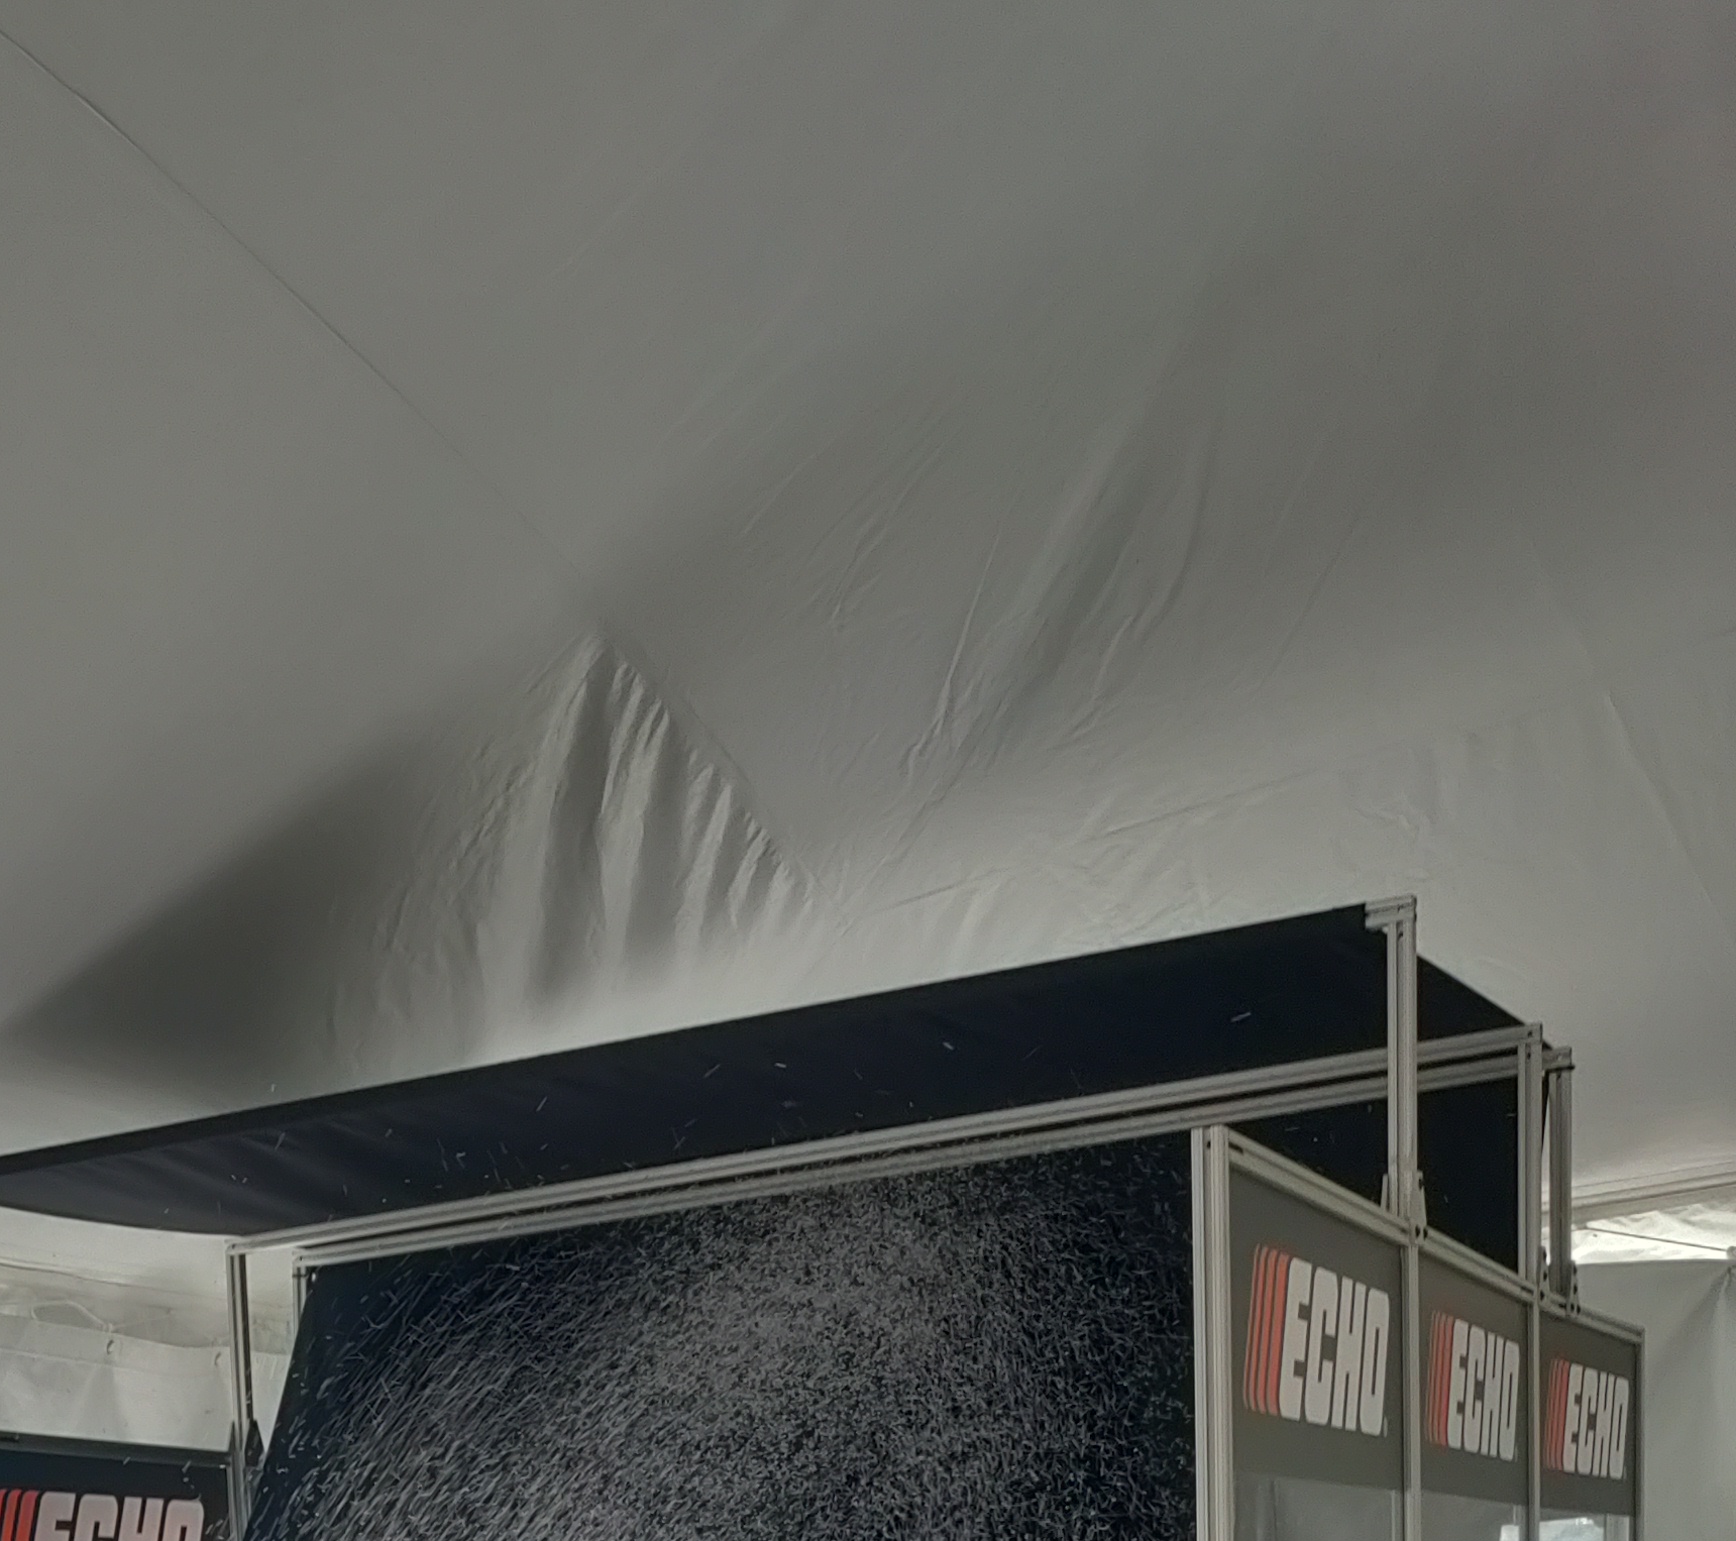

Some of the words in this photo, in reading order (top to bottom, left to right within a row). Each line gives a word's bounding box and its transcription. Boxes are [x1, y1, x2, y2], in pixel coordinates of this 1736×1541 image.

[1279, 1257, 1390, 1436] ECHO
[1447, 1319, 1520, 1461] ECHO
[1563, 1363, 1629, 1479] ECHO
